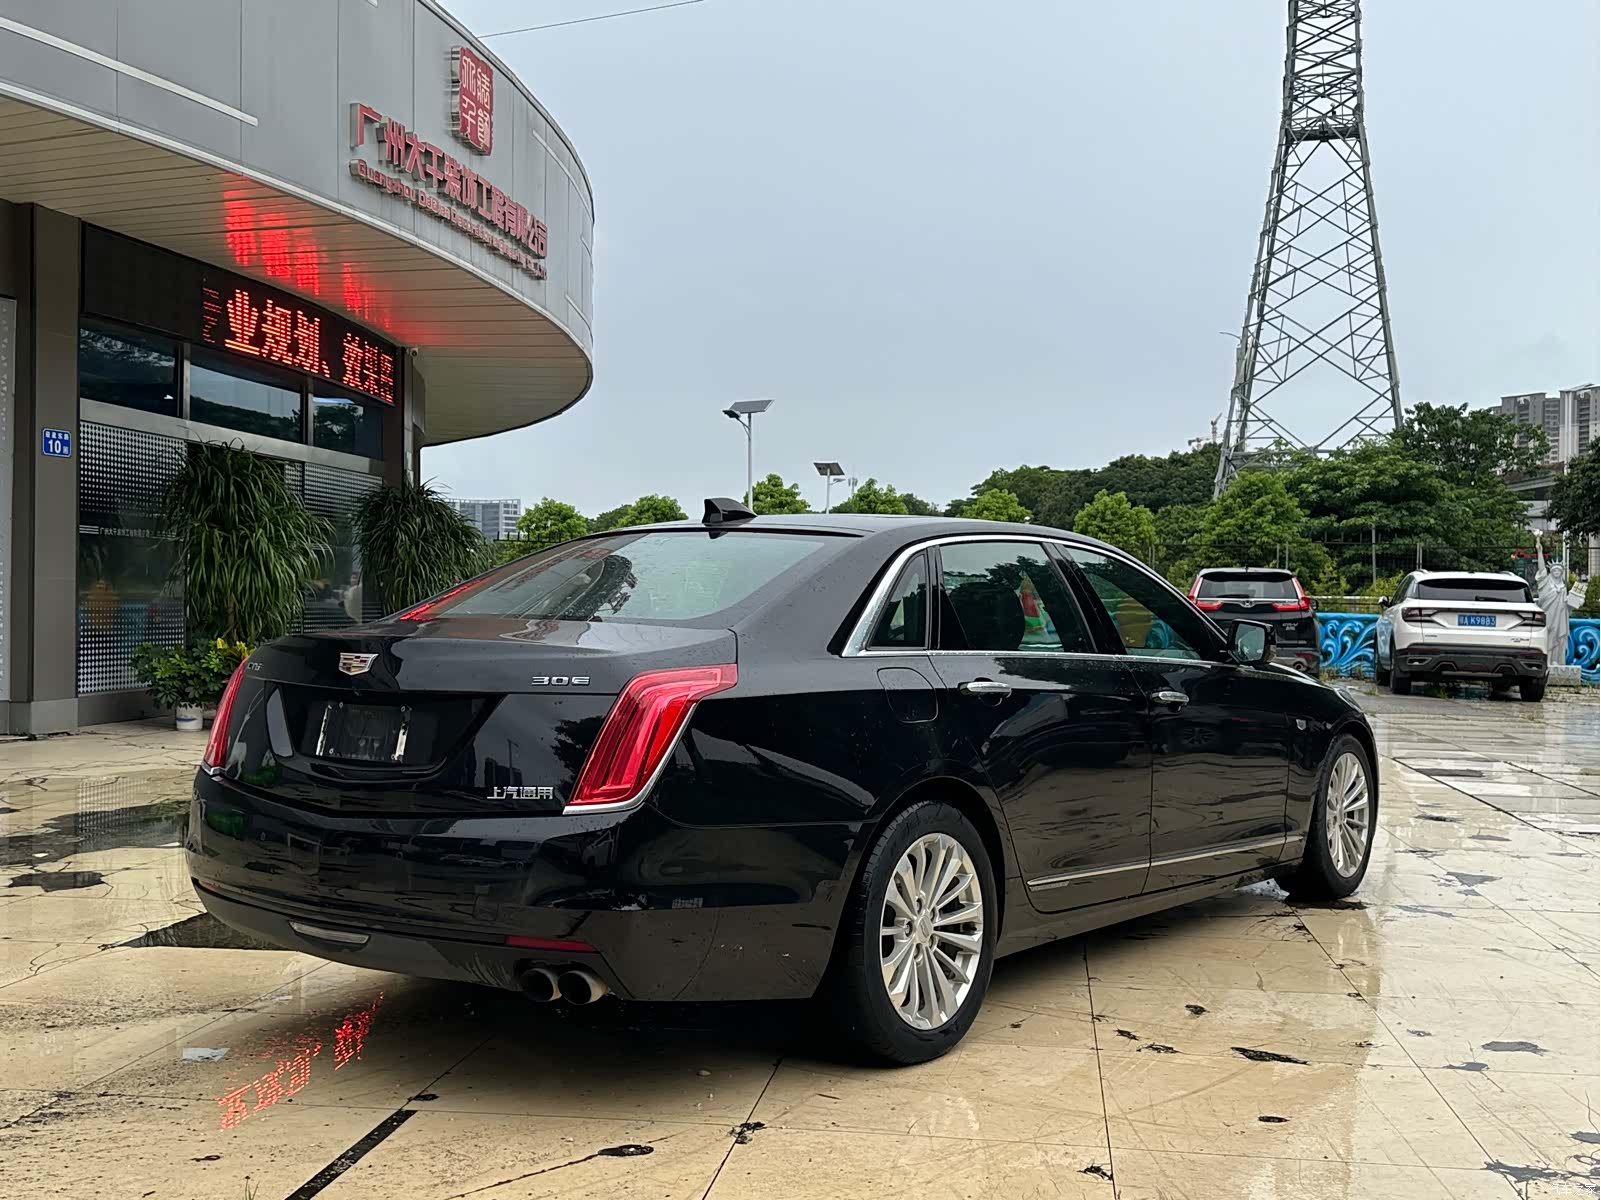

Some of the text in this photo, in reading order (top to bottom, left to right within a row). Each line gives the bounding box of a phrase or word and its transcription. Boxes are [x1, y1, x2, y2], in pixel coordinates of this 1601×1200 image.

[356, 159, 416, 201] Guangzhou
[1458, 615, 1496, 627] AK9883
[486, 786, 554, 800] 上汽通用
